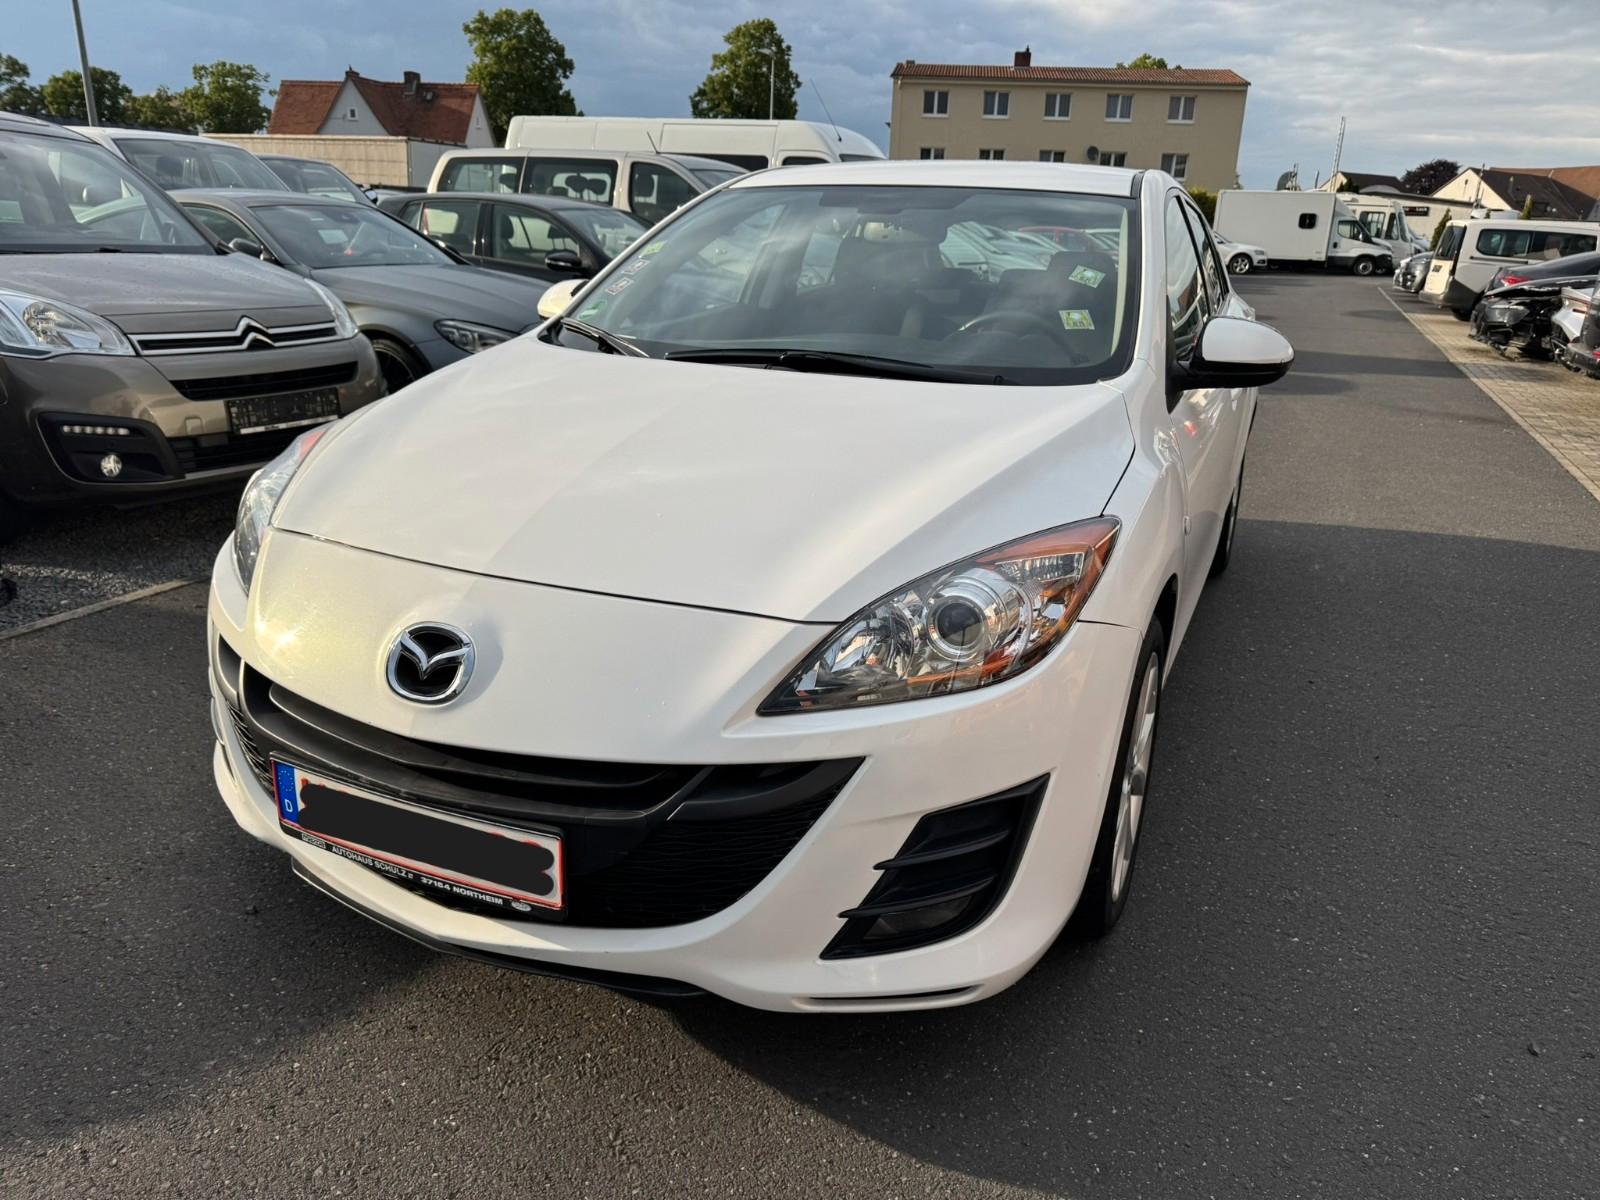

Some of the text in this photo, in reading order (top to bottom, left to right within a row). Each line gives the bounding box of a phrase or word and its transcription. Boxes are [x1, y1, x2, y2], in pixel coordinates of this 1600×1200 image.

[284, 798, 293, 813] D
[331, 846, 374, 866] AUTOHAUS
[374, 860, 407, 878] SCHULZ
[452, 886, 504, 906] NORTHEIM
